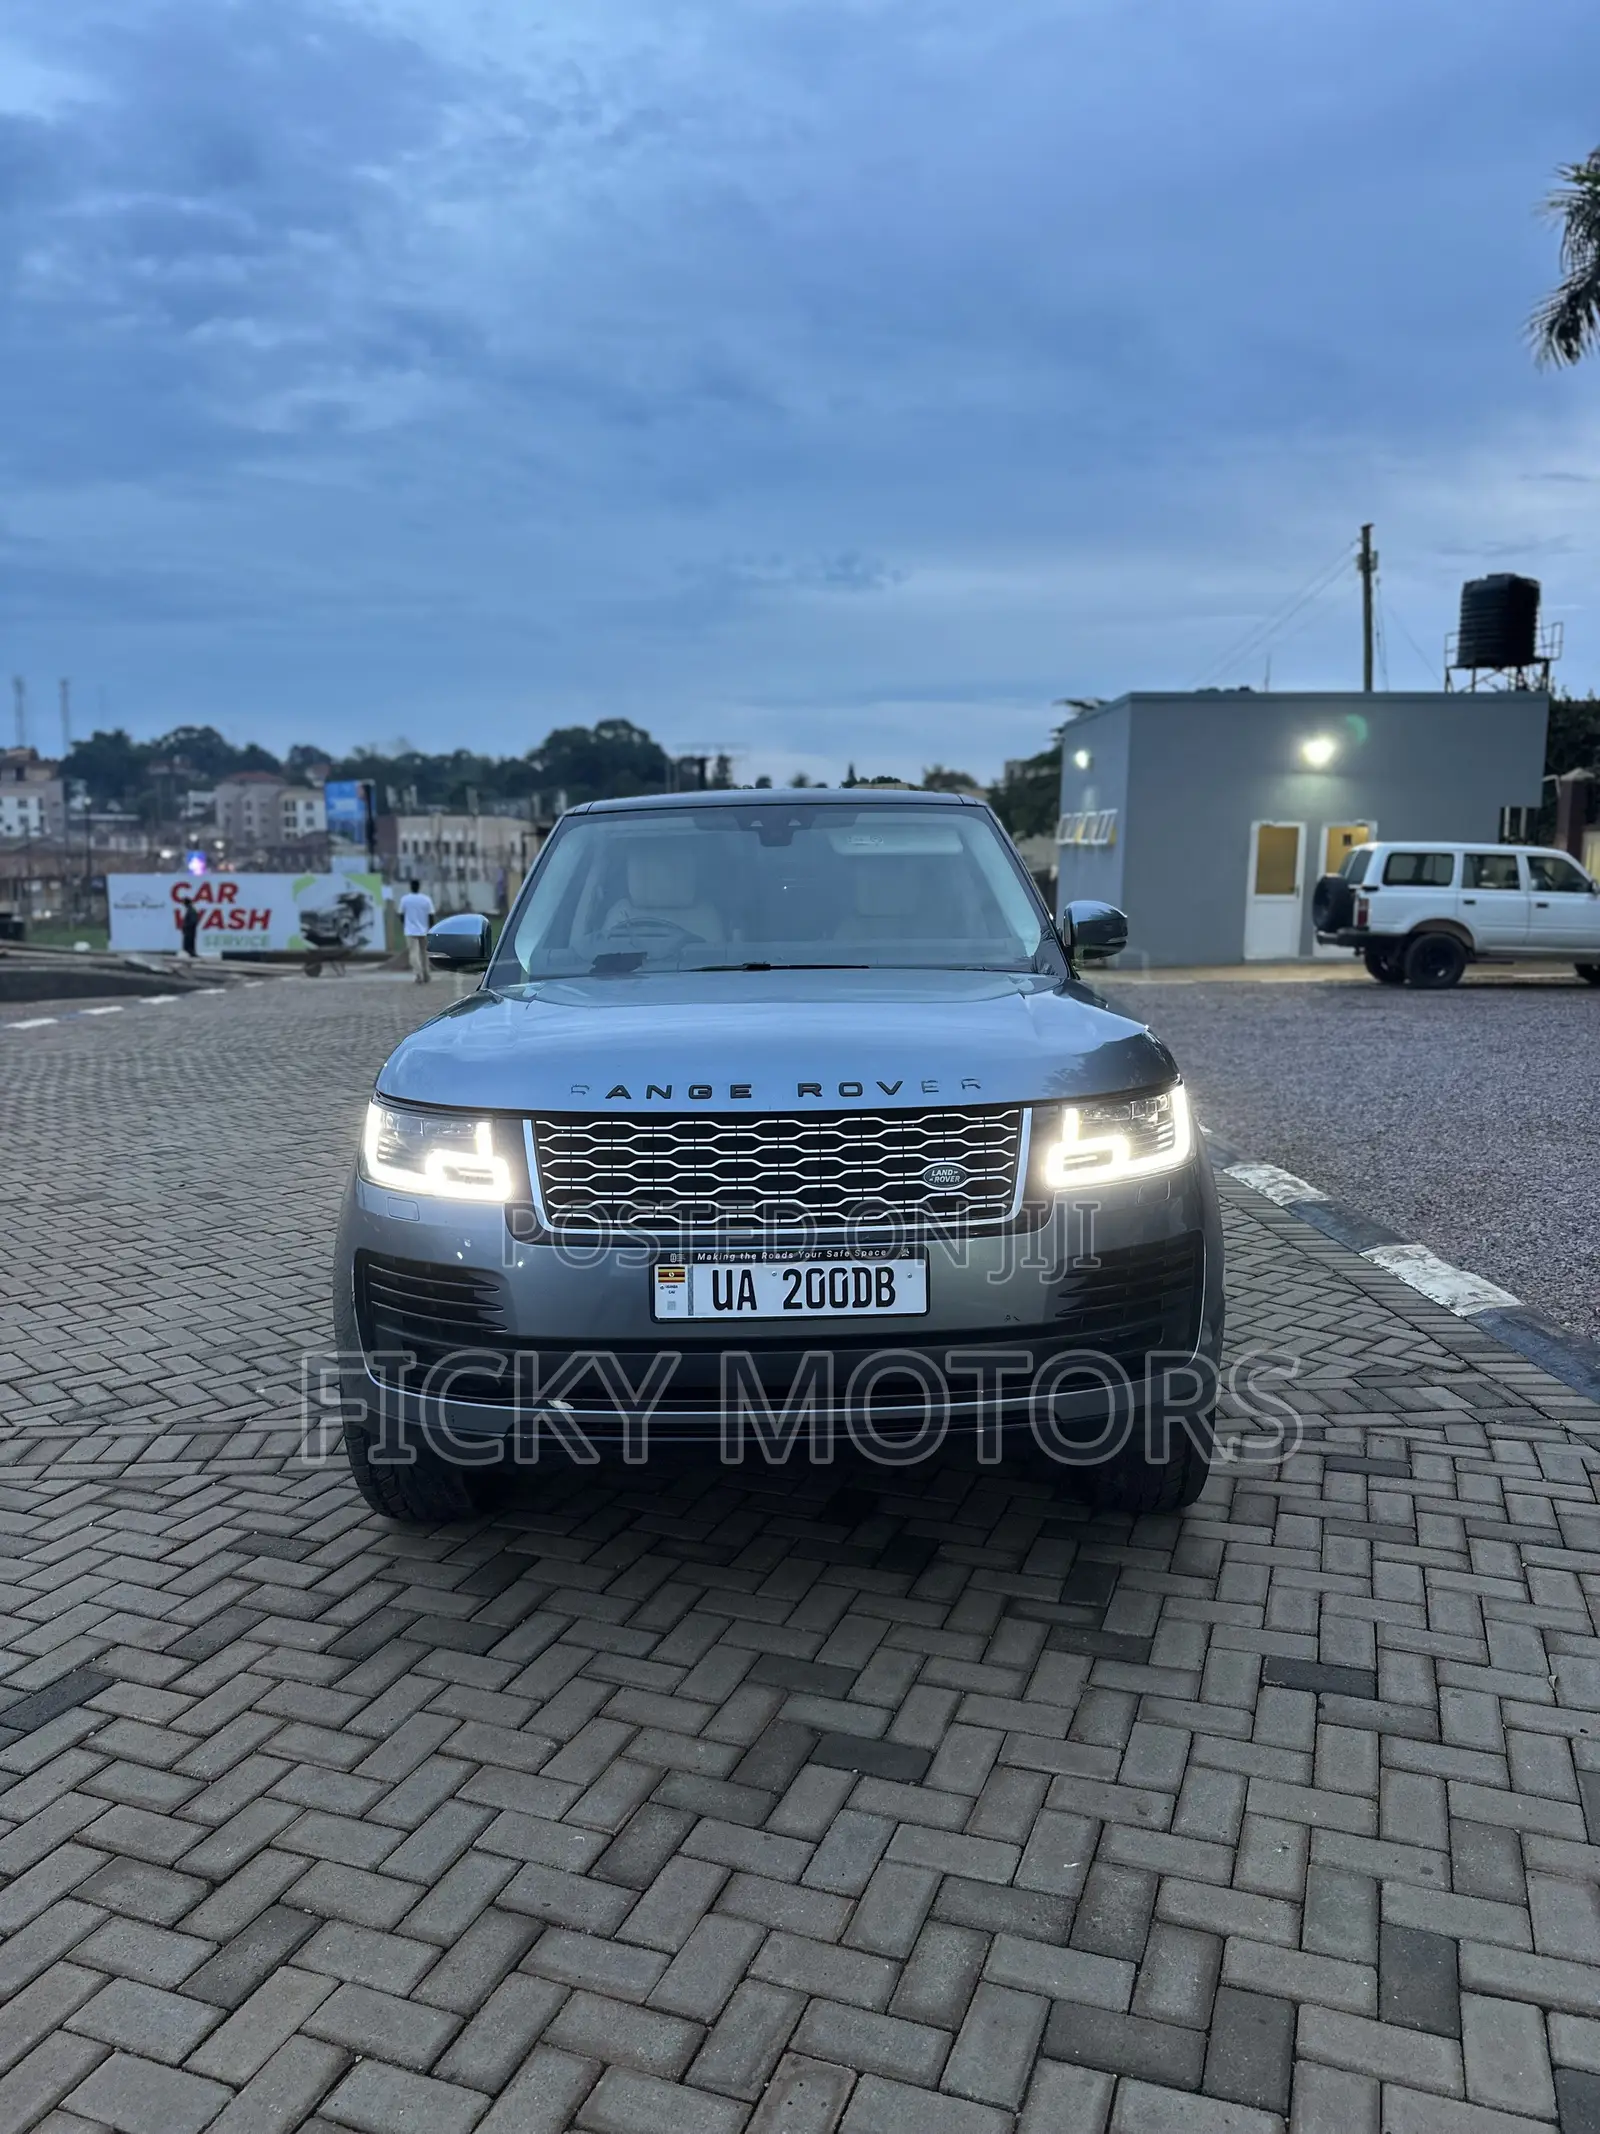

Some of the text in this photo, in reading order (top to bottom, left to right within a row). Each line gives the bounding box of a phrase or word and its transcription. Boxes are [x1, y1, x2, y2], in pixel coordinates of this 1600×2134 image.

[171, 881, 239, 904] CAR
[204, 934, 270, 948] SERVICE
[797, 1078, 982, 1098] ROVER
[931, 1169, 953, 1177] LAND
[697, 1248, 887, 1262] Making the Roads Your Safe Space
[712, 1266, 896, 1311] UA 200DB
